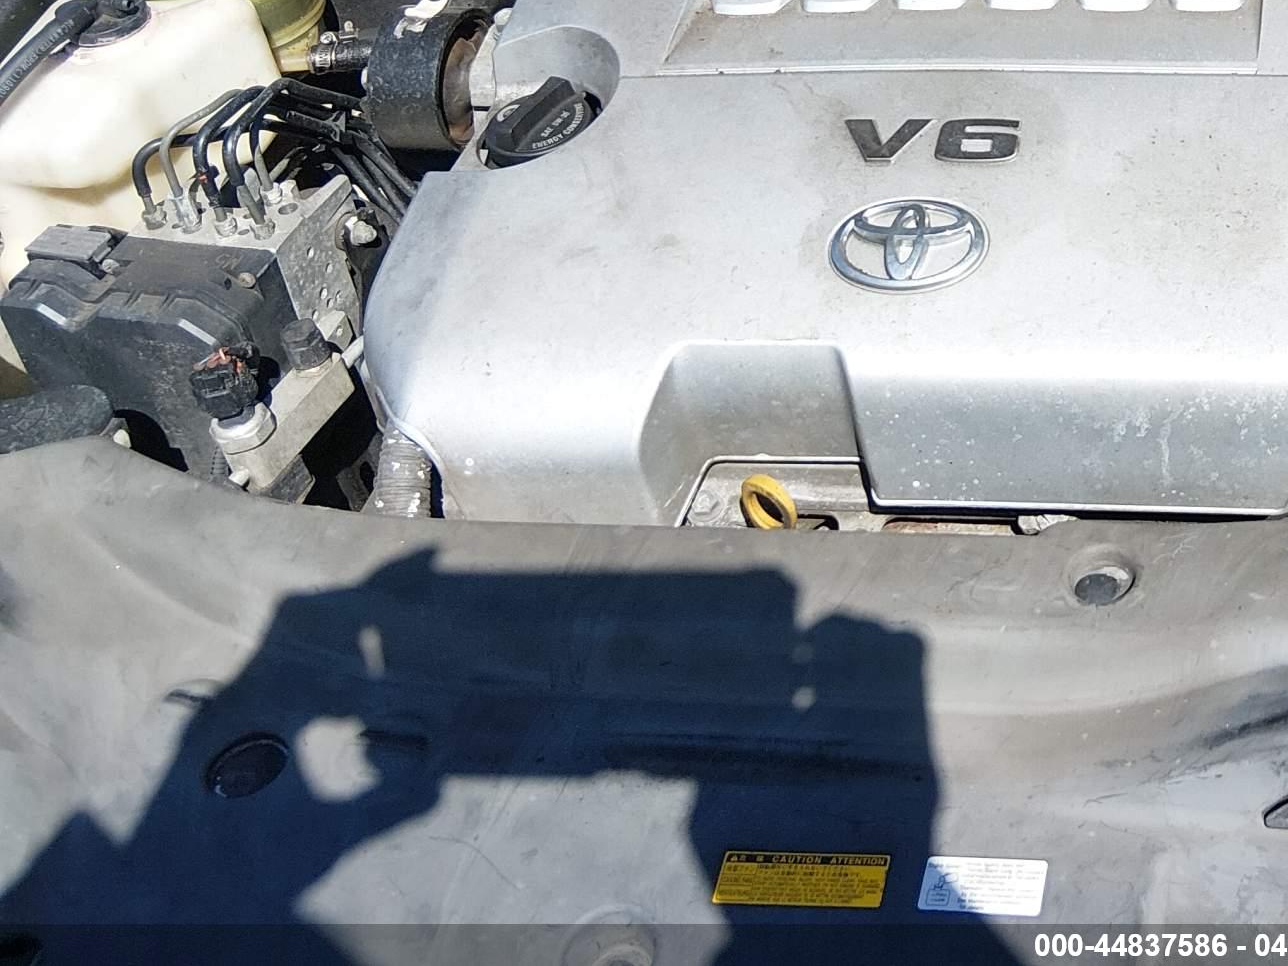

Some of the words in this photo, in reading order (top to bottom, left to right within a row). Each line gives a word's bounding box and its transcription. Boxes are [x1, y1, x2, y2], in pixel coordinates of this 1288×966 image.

[845, 119, 1022, 162] V6
[772, 856, 822, 864] CAUTION
[830, 857, 885, 865] ATTENTION
